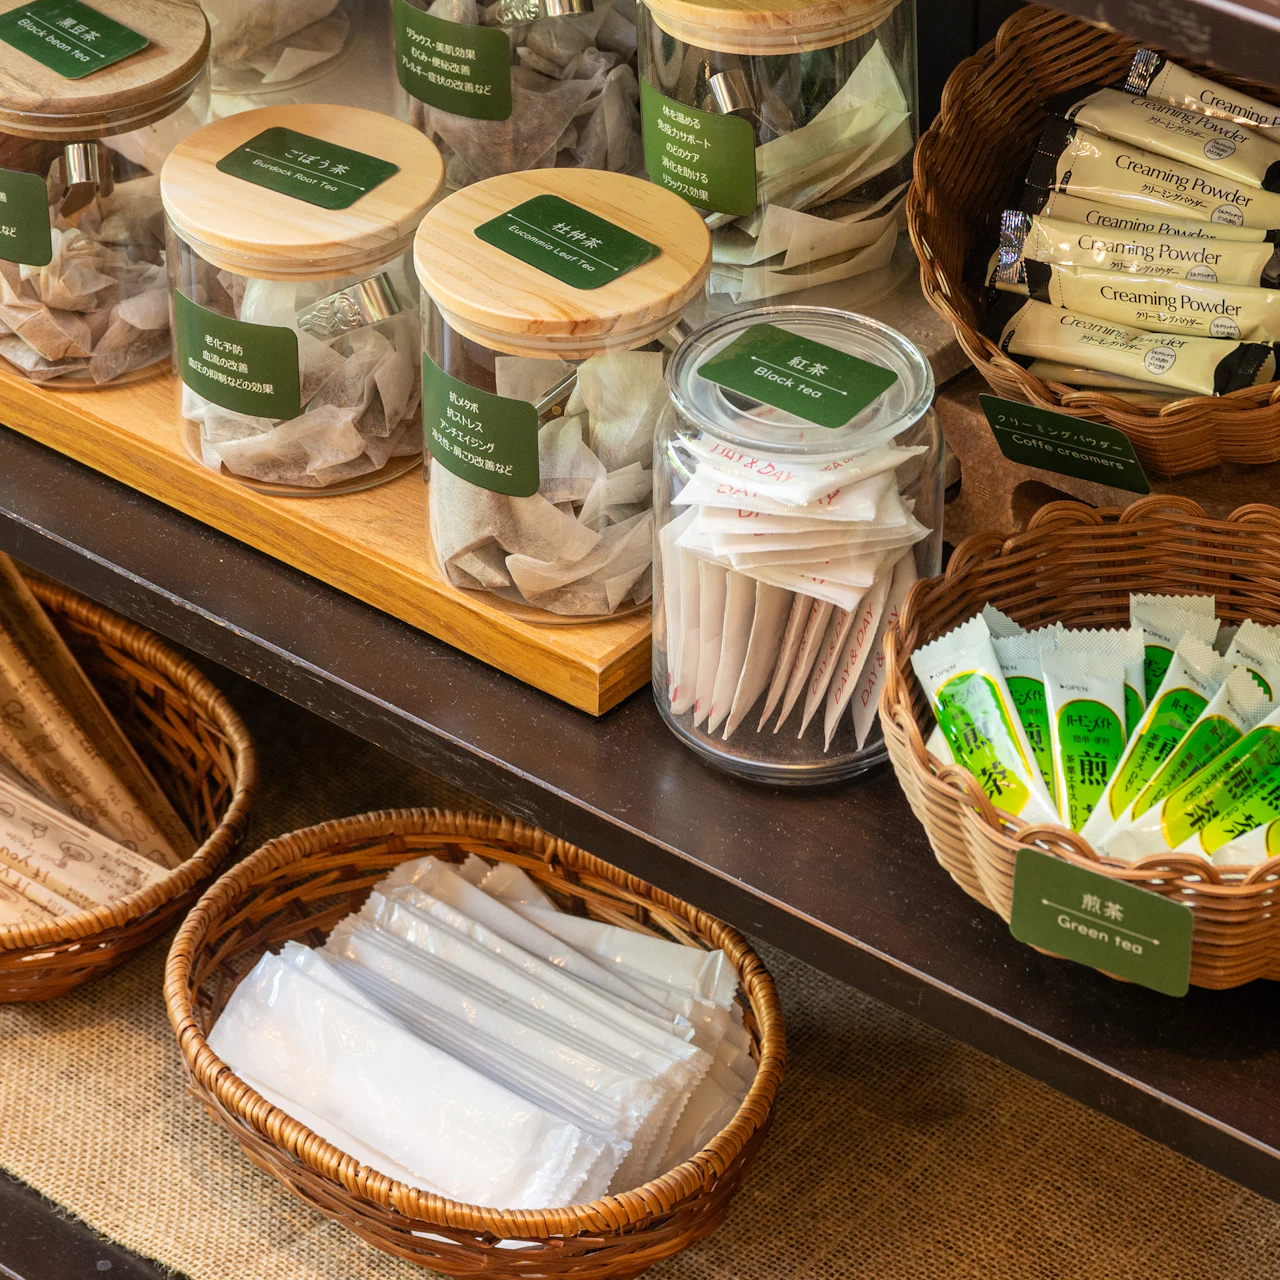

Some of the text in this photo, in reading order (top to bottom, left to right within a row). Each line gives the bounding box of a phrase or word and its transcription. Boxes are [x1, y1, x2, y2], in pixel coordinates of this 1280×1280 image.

[16, 17, 91, 64] Black bean tea
[57, 16, 102, 42] 黒豆茶
[406, 26, 476, 60] リラックス・美肌効果
[401, 54, 492, 95] アレルギー症状の改善など
[411, 46, 470, 76] むくみ・便秘改善
[662, 105, 701, 130] 体を温める
[1131, 96, 1250, 144] Creaming Powder
[1149, 116, 1206, 139] クリーミングパウダー
[657, 118, 711, 149] 免疫力サポート
[283, 147, 350, 177] ごぼう茶
[665, 142, 699, 163] のどのケア
[252, 158, 338, 193] Burdock Root Tea
[661, 155, 708, 184] 消化を助ける
[1115, 154, 1253, 207] Creaming Powder
[663, 173, 709, 202] リラックス効果
[1141, 183, 1208, 209] クリーミングパウダー
[508, 223, 595, 274] Eucommia Leaf Tea
[551, 221, 604, 250] 杜仲茶
[1078, 235, 1222, 265] Creaming Powder
[1100, 285, 1241, 316] Creaming Powder
[1060, 314, 1129, 342] Creaming
[1136, 311, 1203, 326] クリーミングパウダー
[205, 334, 243, 356] 老化予防
[188, 357, 274, 395] 血圧の抑制などの効果
[202, 350, 248, 374] 血流の改善
[786, 355, 828, 377] 紅茶
[753, 366, 823, 400] Black tea
[449, 391, 479, 413] 抗メタボ
[446, 406, 483, 433] 抗ストレス
[997, 414, 1124, 453] クリーミングパウダー
[440, 418, 495, 453] アンチエイジング
[432, 427, 513, 476] 冷え性・肩こり改善など
[1057, 446, 1125, 471] creamers
[744, 459, 798, 483] & DAY
[1148, 630, 1171, 643] OPEN
[834, 603, 872, 705] DAY & DAY
[1241, 652, 1263, 666] OPEN
[861, 664, 878, 707] DAY
[0, 845, 32, 867] you
[10, 876, 32, 897] If
[31, 870, 51, 884] If
[1080, 892, 1126, 922] 煎茶
[1057, 914, 1144, 956] Green tea
